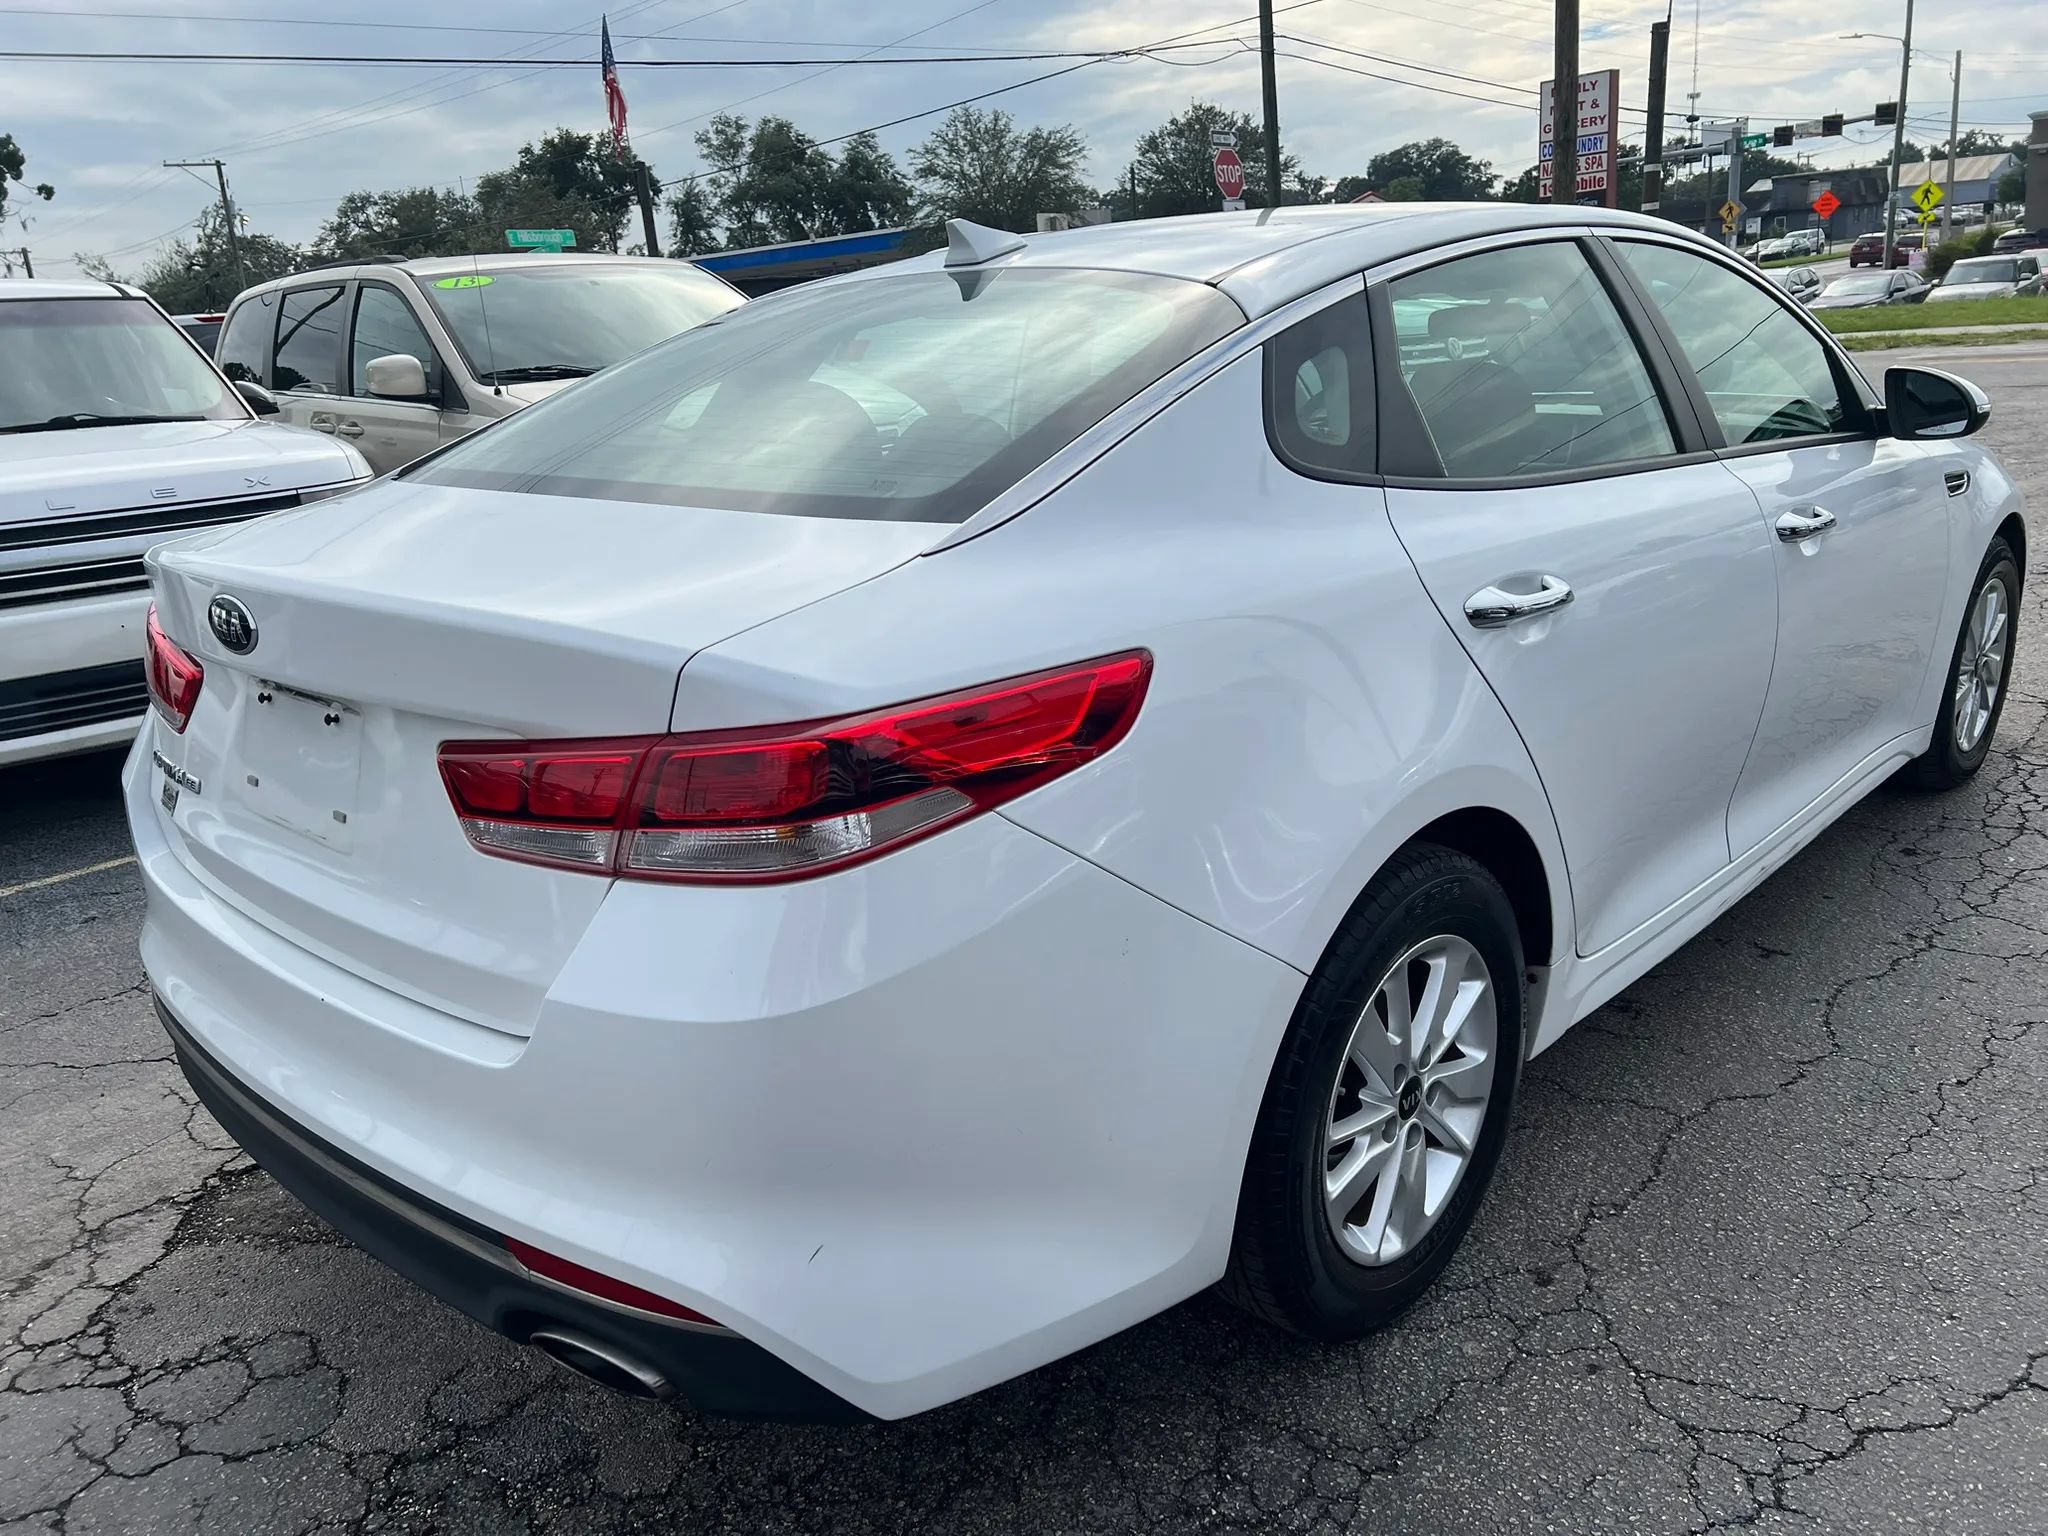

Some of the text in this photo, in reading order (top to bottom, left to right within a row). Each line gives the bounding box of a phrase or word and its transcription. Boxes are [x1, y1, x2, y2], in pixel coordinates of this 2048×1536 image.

[1590, 99, 1600, 109] &
[1543, 114, 1607, 133] GERY
[1584, 155, 1604, 171] SPA
[1217, 164, 1241, 183] STOP
[453, 276, 477, 288] 13
